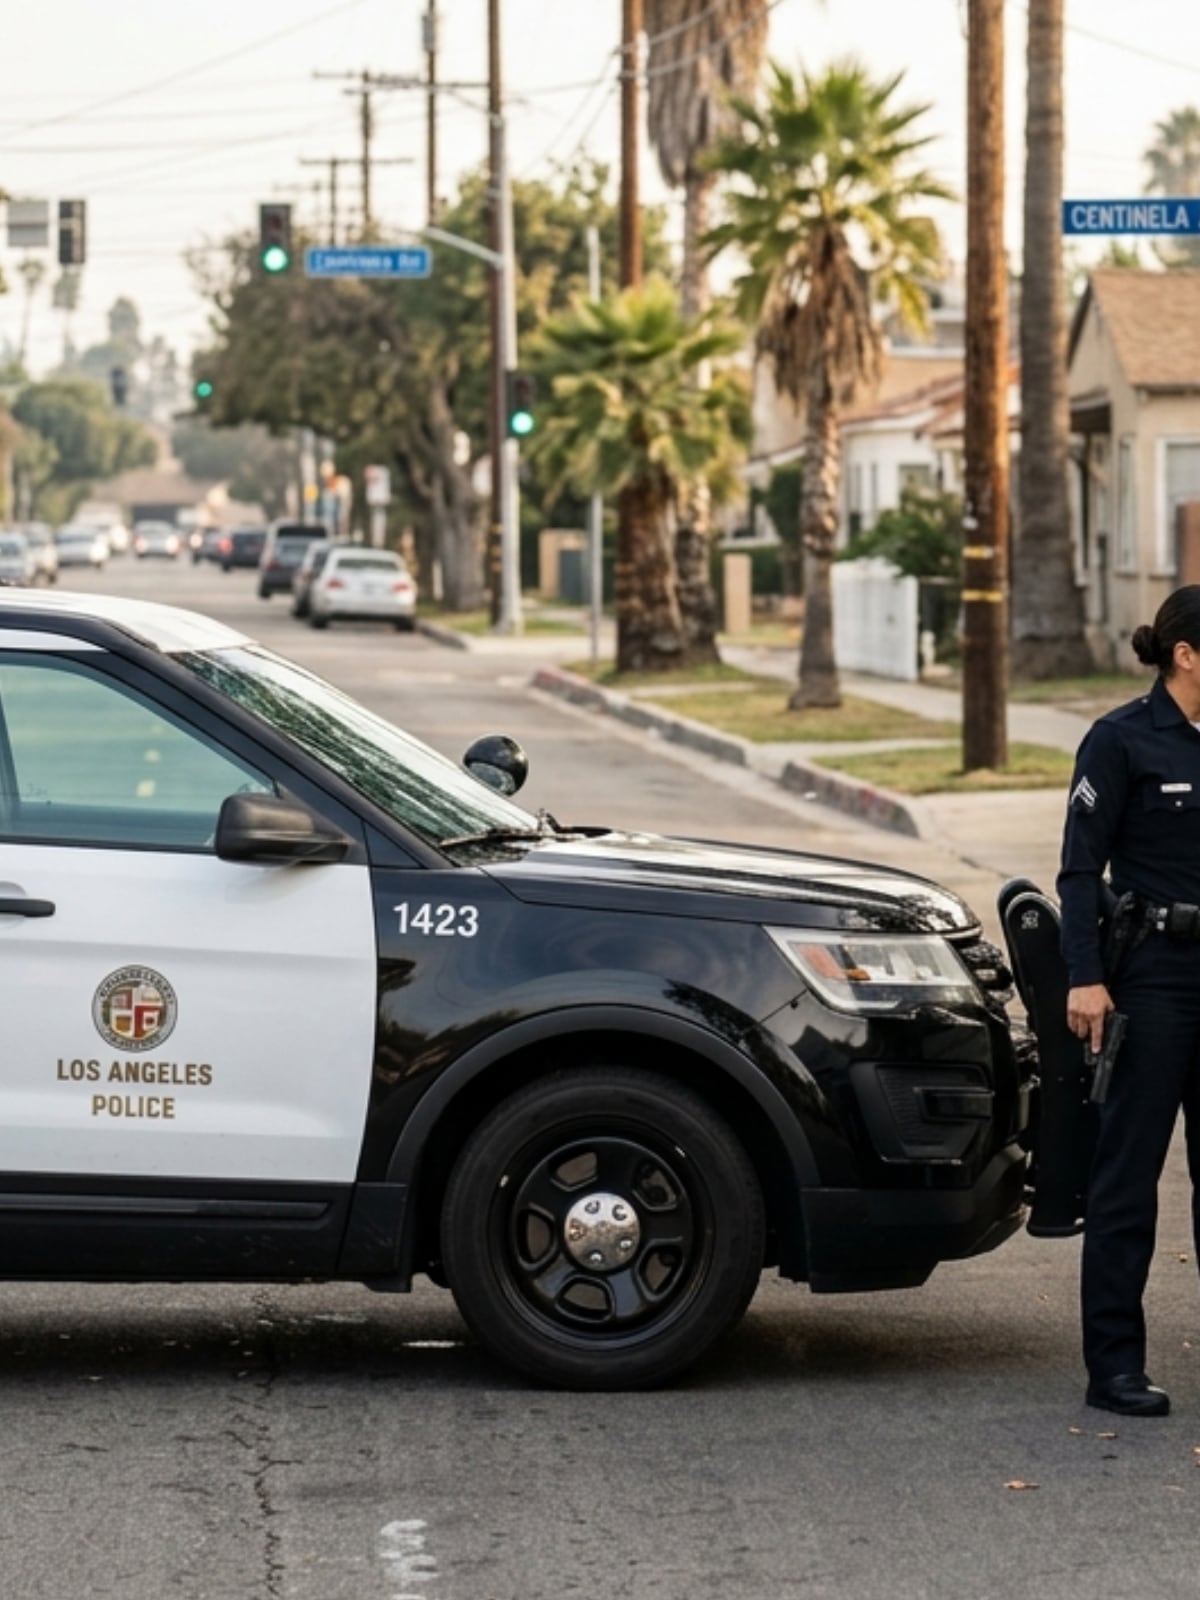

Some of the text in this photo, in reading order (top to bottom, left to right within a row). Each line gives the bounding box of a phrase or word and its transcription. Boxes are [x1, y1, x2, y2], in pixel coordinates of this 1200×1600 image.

[1071, 204, 1189, 229] CENTINELA
[393, 902, 479, 938] 1423
[57, 1059, 213, 1086] LOS ANGELES
[92, 1095, 175, 1119] POLICE
